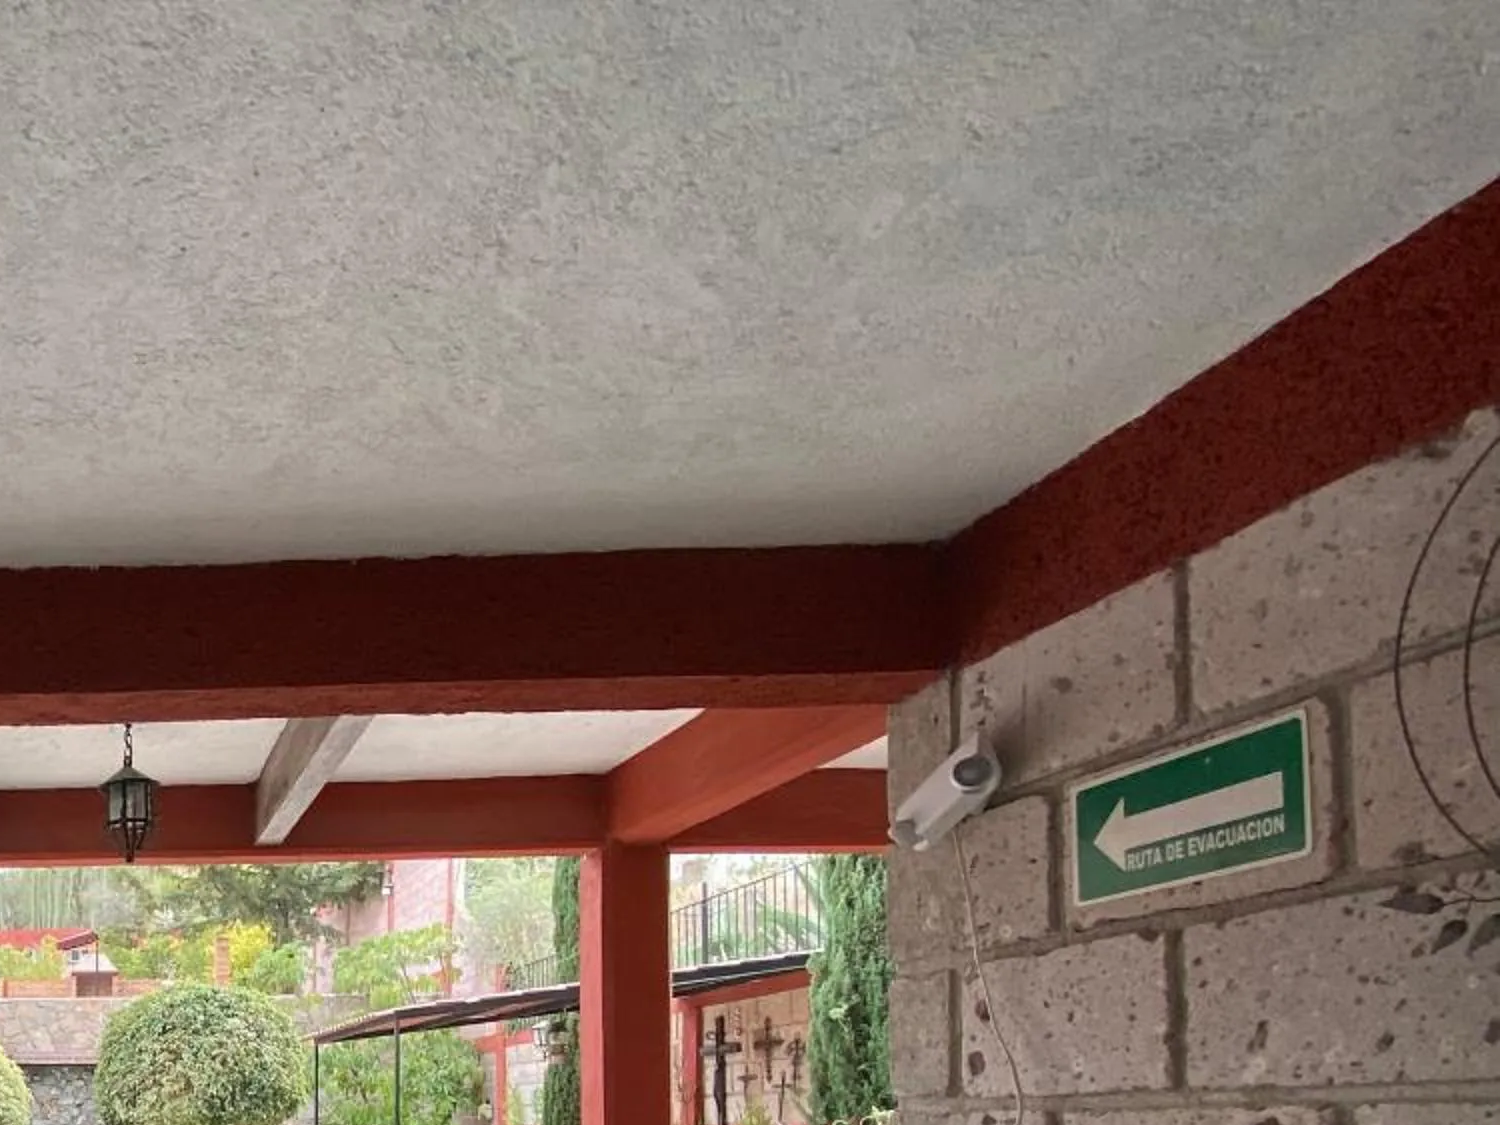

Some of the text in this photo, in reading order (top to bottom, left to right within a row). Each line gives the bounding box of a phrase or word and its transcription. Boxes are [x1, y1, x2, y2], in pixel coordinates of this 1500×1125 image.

[1127, 813, 1285, 872] RUTA DE EVACUACION
